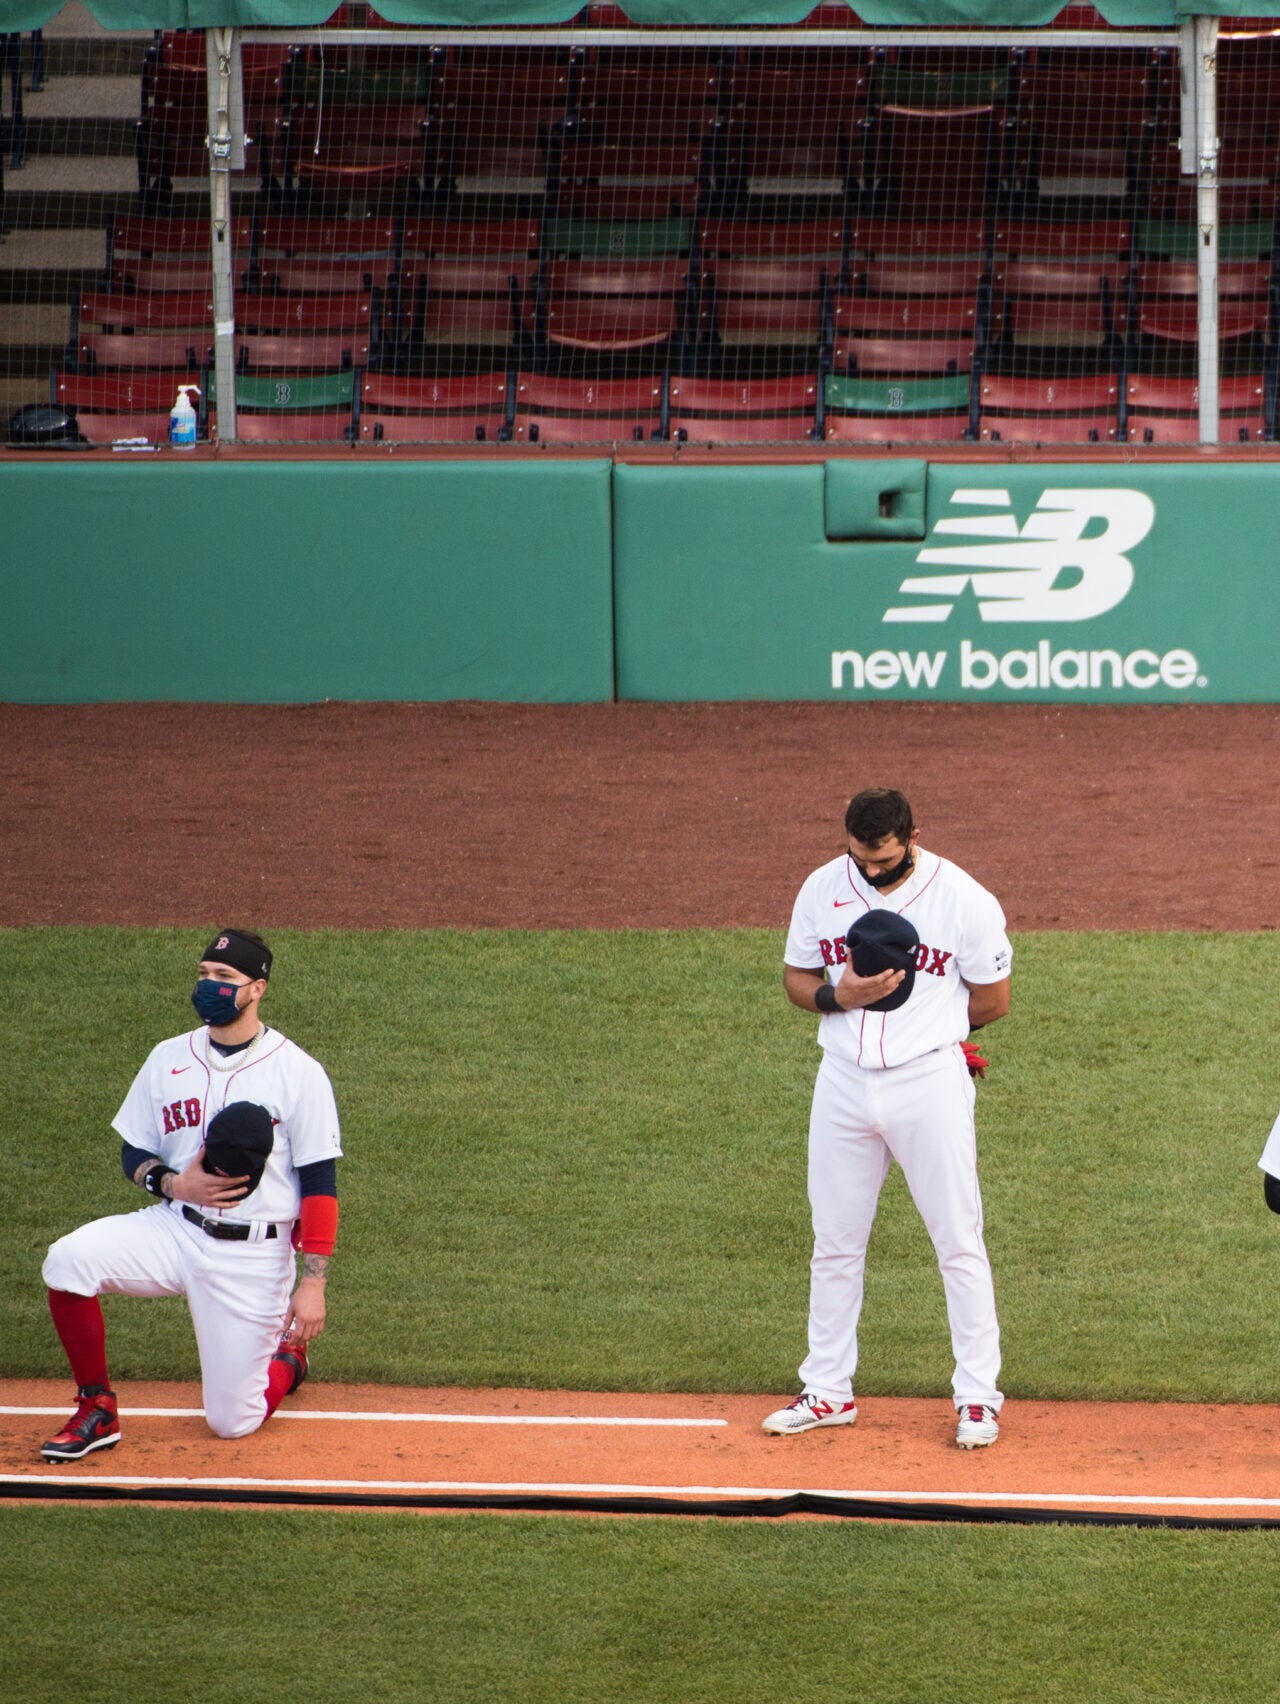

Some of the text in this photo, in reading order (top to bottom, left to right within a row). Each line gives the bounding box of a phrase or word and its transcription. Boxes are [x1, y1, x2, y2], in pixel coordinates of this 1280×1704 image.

[275, 384, 291, 404] B
[888, 387, 904, 409] B
[831, 649, 947, 689] new
[214, 936, 230, 950] B
[819, 935, 953, 977] RE OX
[162, 1097, 202, 1136] RED
